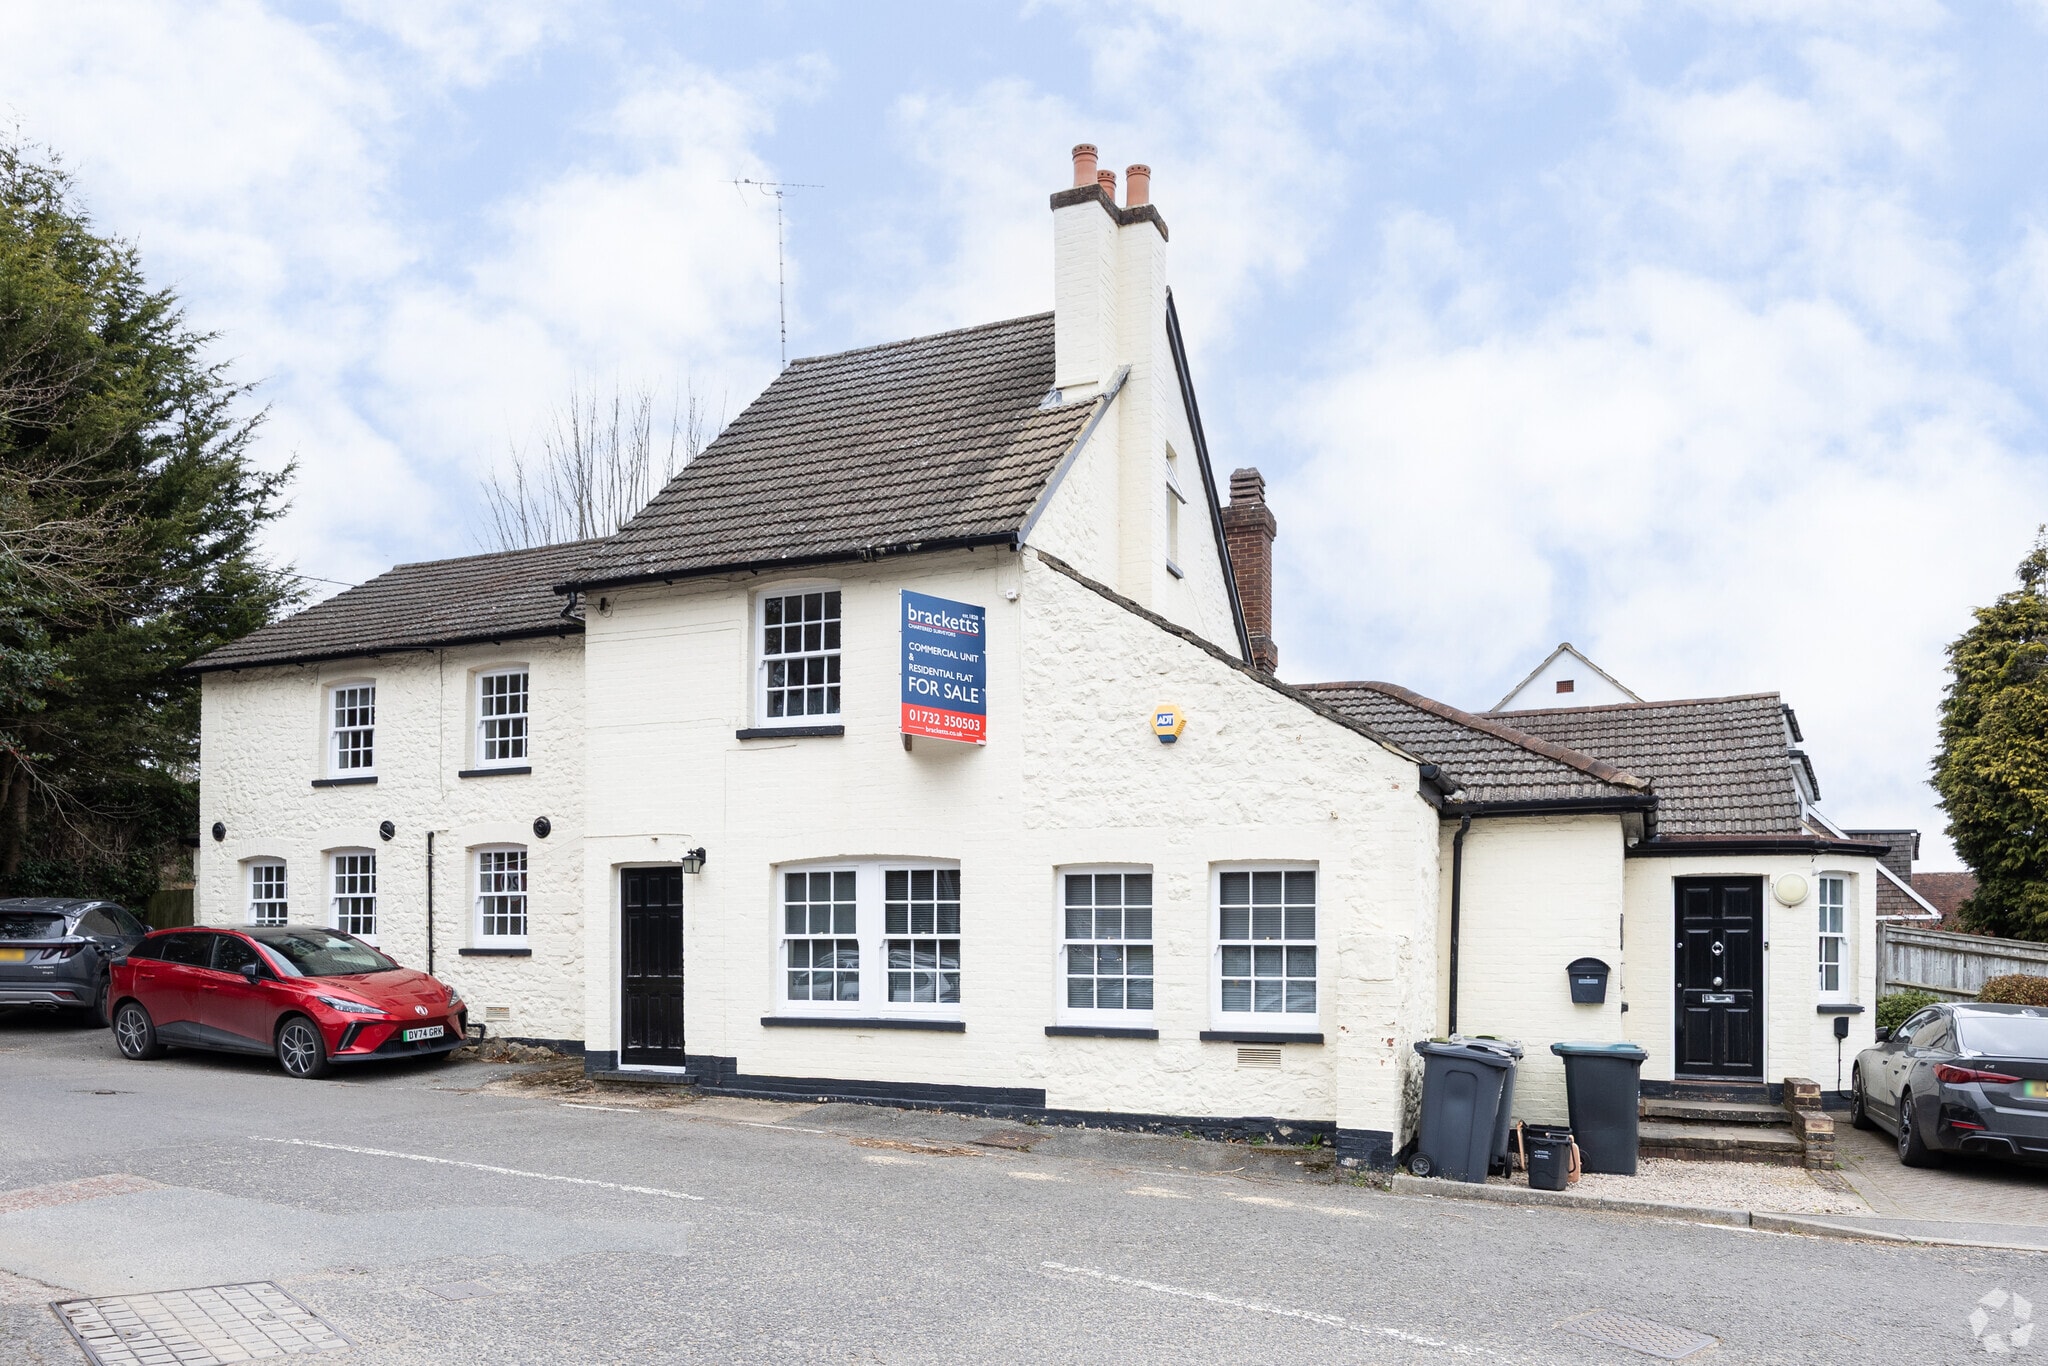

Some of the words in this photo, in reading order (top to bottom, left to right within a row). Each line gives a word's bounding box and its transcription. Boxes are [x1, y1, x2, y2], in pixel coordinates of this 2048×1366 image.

[908, 602, 979, 634] bracketts
[908, 623, 933, 633] CHARTERED
[933, 628, 957, 638] SURVEYORS
[908, 641, 958, 660] COMMERCIAL
[960, 652, 979, 663] UNIT
[908, 652, 915, 662] &
[908, 662, 955, 680] RESIDENTIAL
[956, 672, 974, 683] FLAT
[908, 675, 940, 698] FOR
[943, 682, 979, 704] SALE
[909, 708, 941, 725] 01732
[943, 714, 981, 731] 350503
[1157, 714, 1173, 725] ADT
[925, 725, 963, 738] bracketts.co.uk
[408, 1029, 428, 1040] DV74
[428, 1026, 443, 1037] GRK
